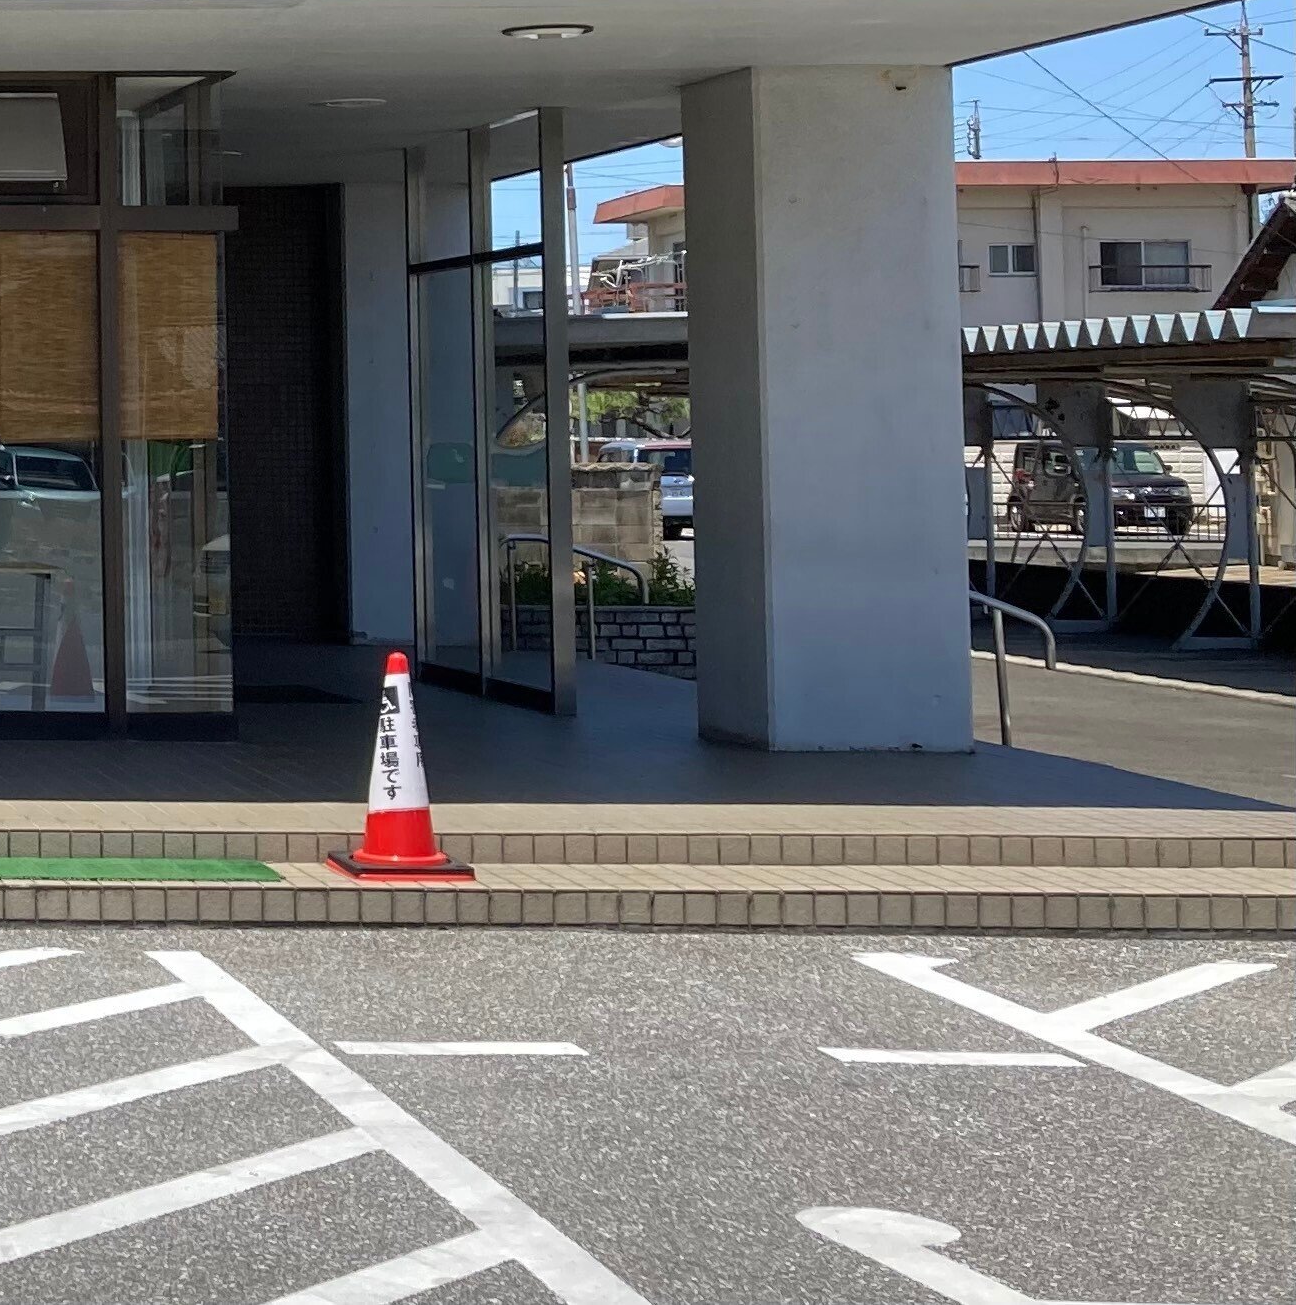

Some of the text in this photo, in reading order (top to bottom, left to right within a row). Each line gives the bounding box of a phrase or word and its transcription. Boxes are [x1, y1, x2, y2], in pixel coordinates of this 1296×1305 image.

[379, 716, 402, 801] 駐車場です
